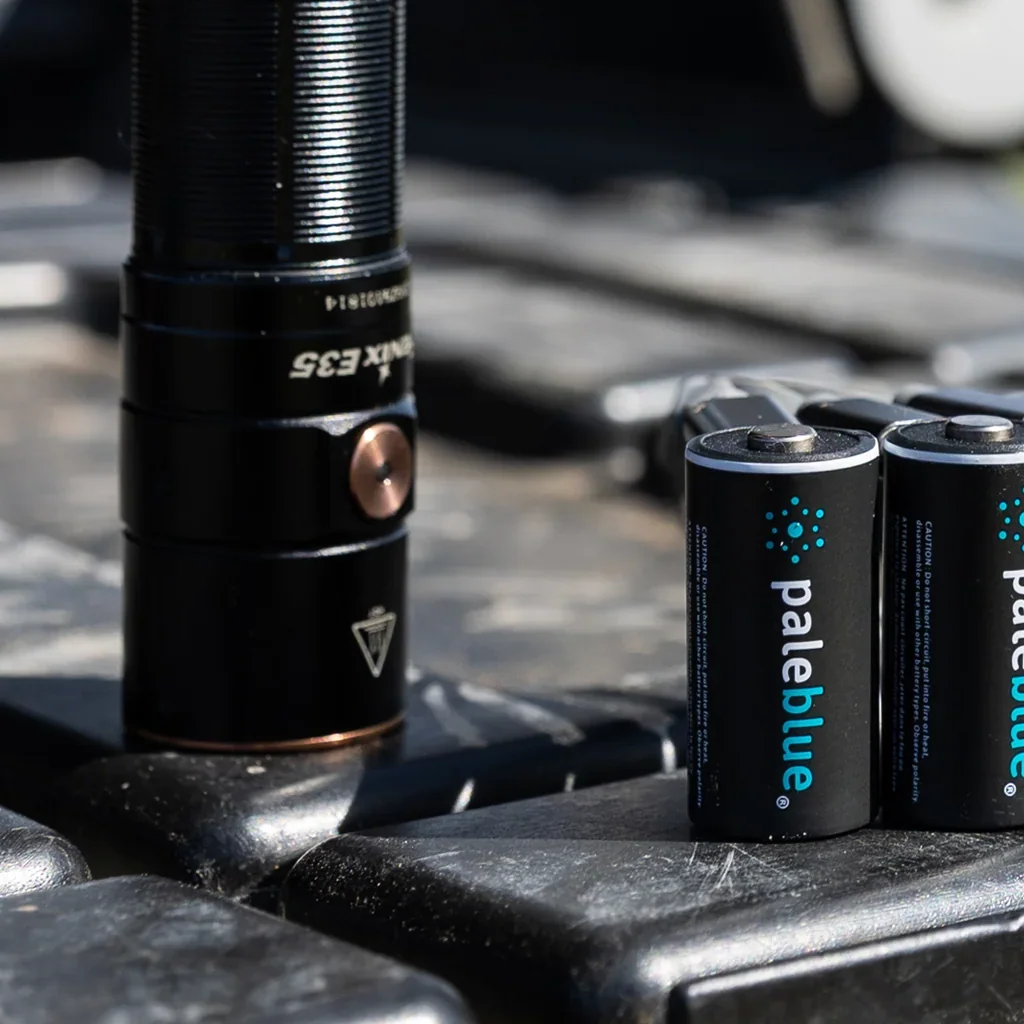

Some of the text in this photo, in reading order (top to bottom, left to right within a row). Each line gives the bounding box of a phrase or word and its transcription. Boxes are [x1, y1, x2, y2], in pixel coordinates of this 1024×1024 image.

[289, 347, 361, 379] E35
[915, 519, 923, 578] disassemble
[915, 579, 921, 589] or
[924, 572, 931, 585] Do
[914, 631, 922, 657] other
[913, 659, 921, 694] battery
[921, 667, 930, 683] put
[922, 684, 930, 703] into
[922, 705, 930, 721] fire
[922, 723, 929, 733] or
